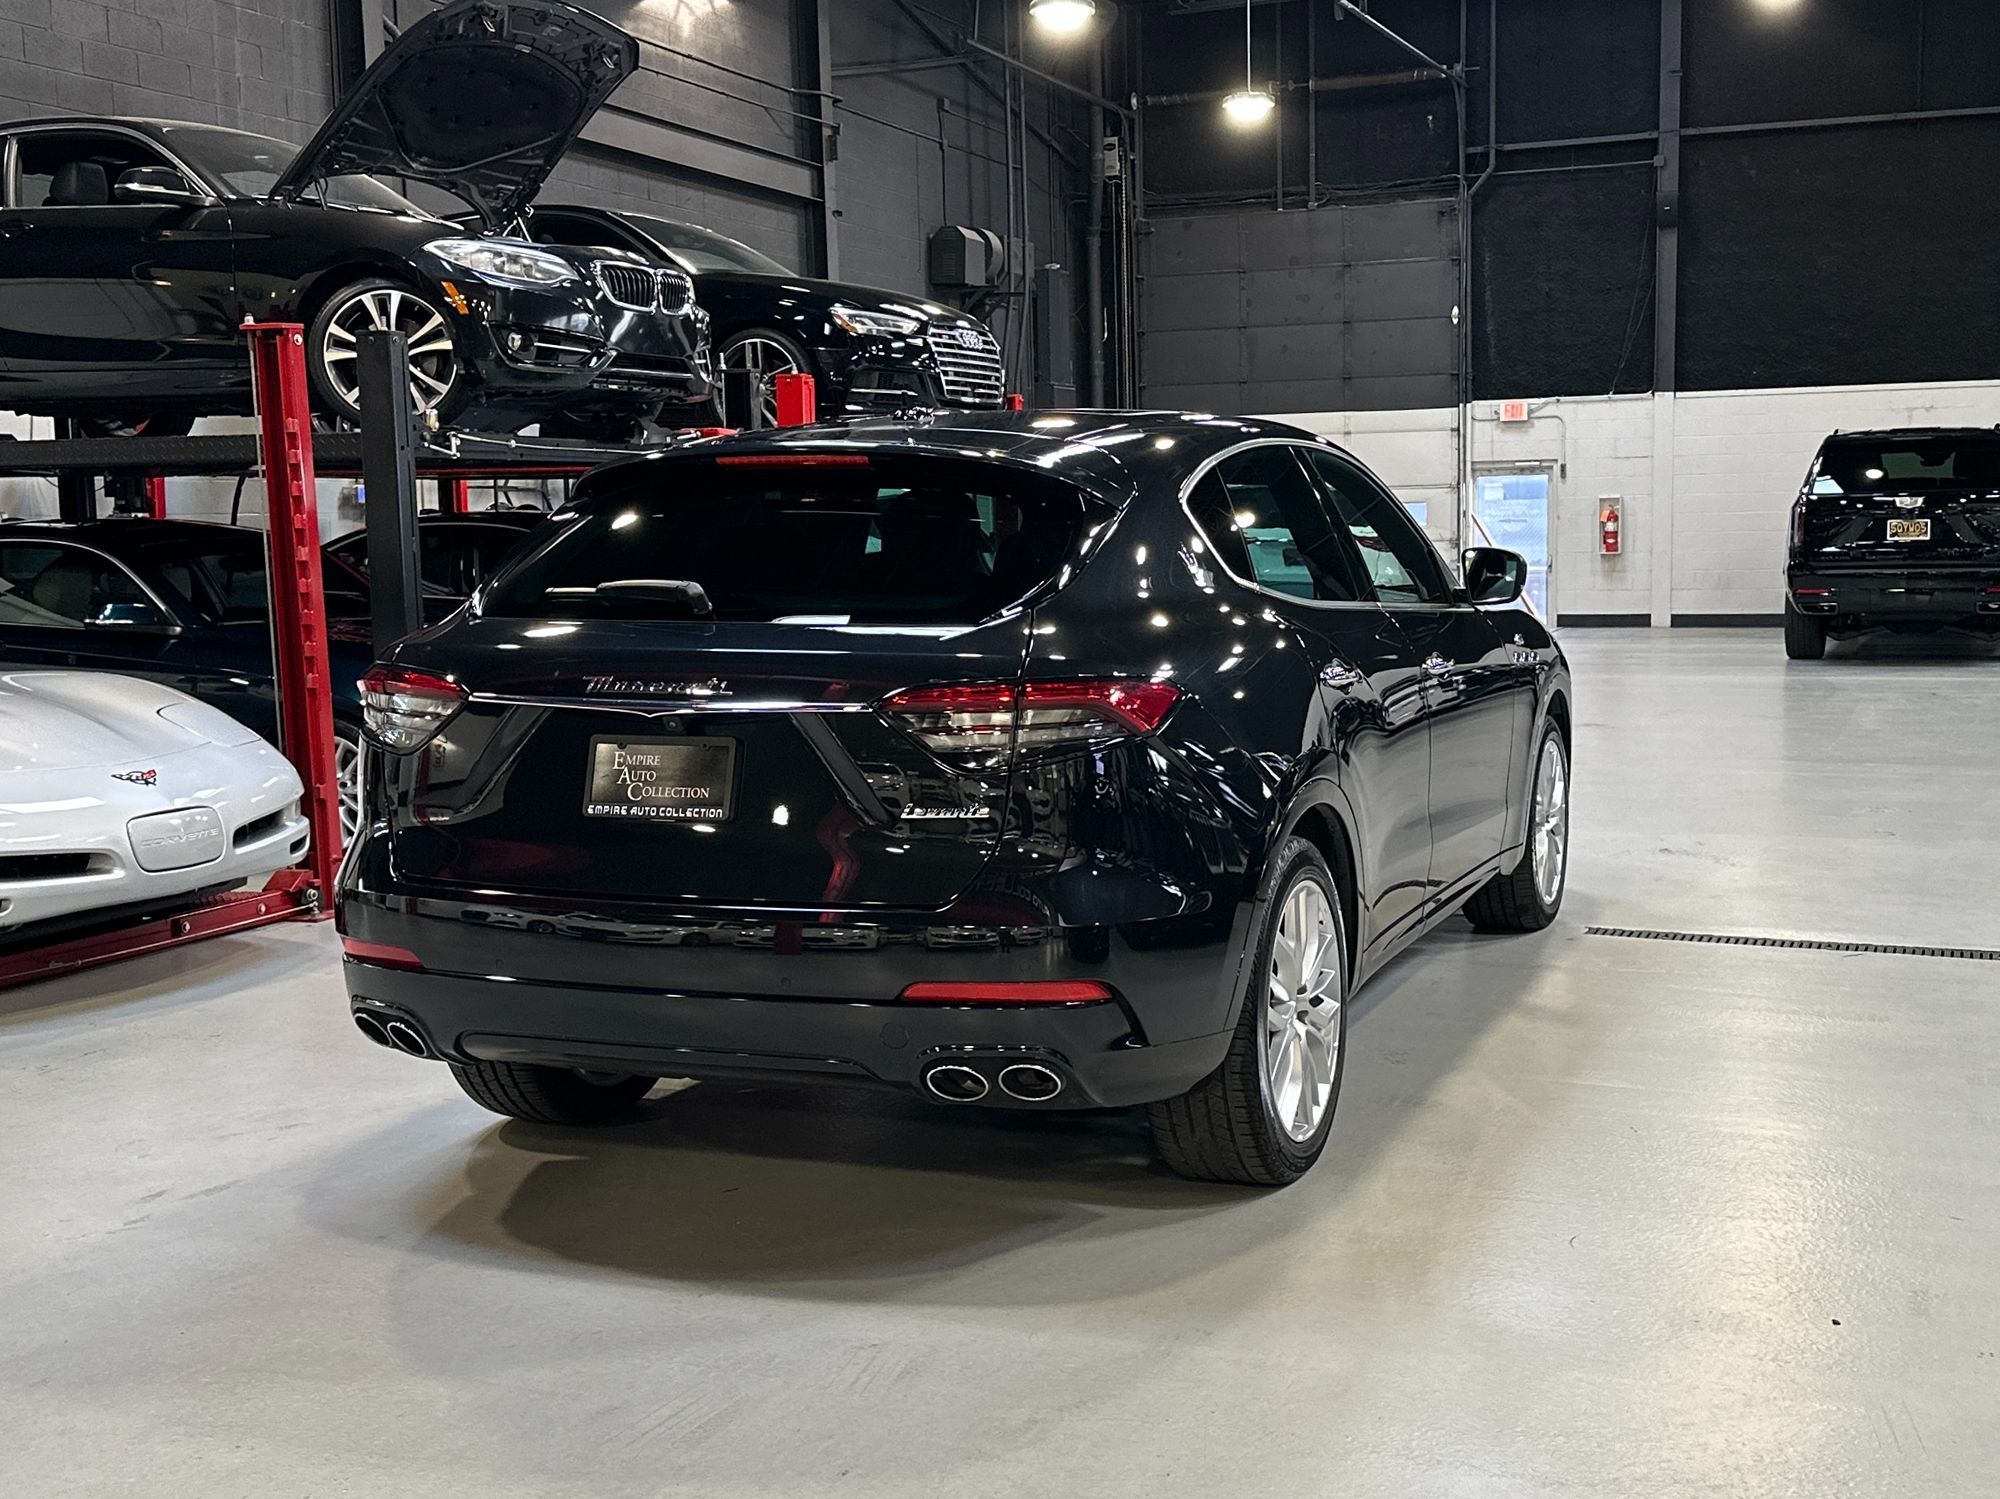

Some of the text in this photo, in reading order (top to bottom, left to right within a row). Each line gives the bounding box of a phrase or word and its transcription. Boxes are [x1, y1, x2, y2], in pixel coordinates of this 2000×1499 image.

[587, 804, 723, 818] EMPIRE AUTO COLLECTION
[141, 828, 219, 848] CORVETTE
